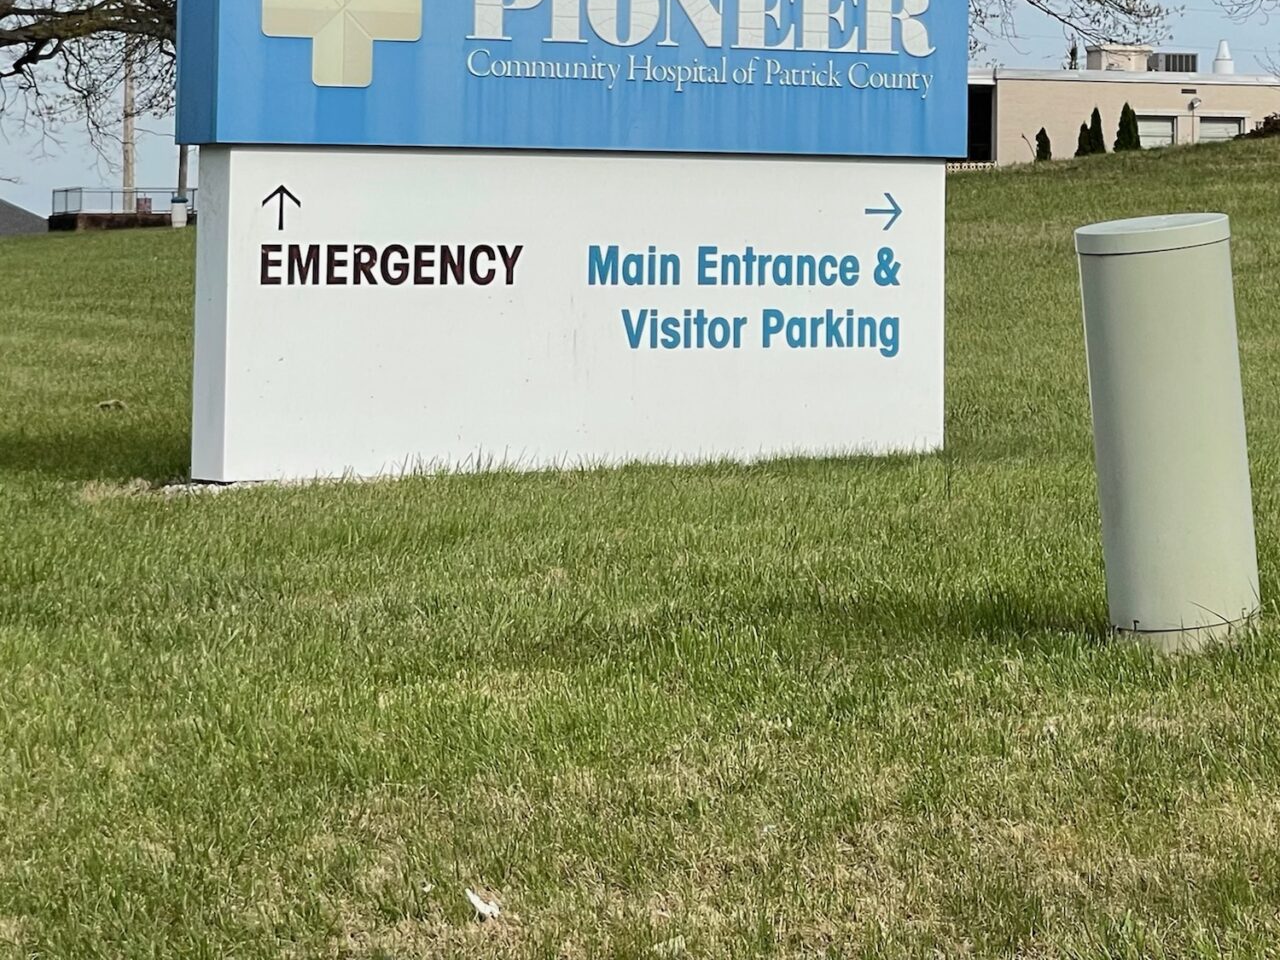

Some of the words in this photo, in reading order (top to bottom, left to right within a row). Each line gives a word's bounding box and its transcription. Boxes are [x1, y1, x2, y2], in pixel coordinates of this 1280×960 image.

[466, 48, 621, 90] Community
[625, 54, 728, 93] Hospital
[732, 56, 760, 86] of
[763, 59, 843, 88] Patrick
[847, 61, 934, 100] County
[260, 243, 524, 286] EMERGENCY
[587, 245, 681, 286] Main
[697, 246, 860, 287] Entrance
[873, 246, 902, 287] &
[620, 308, 748, 350] Visitor
[761, 308, 900, 358] Parking
